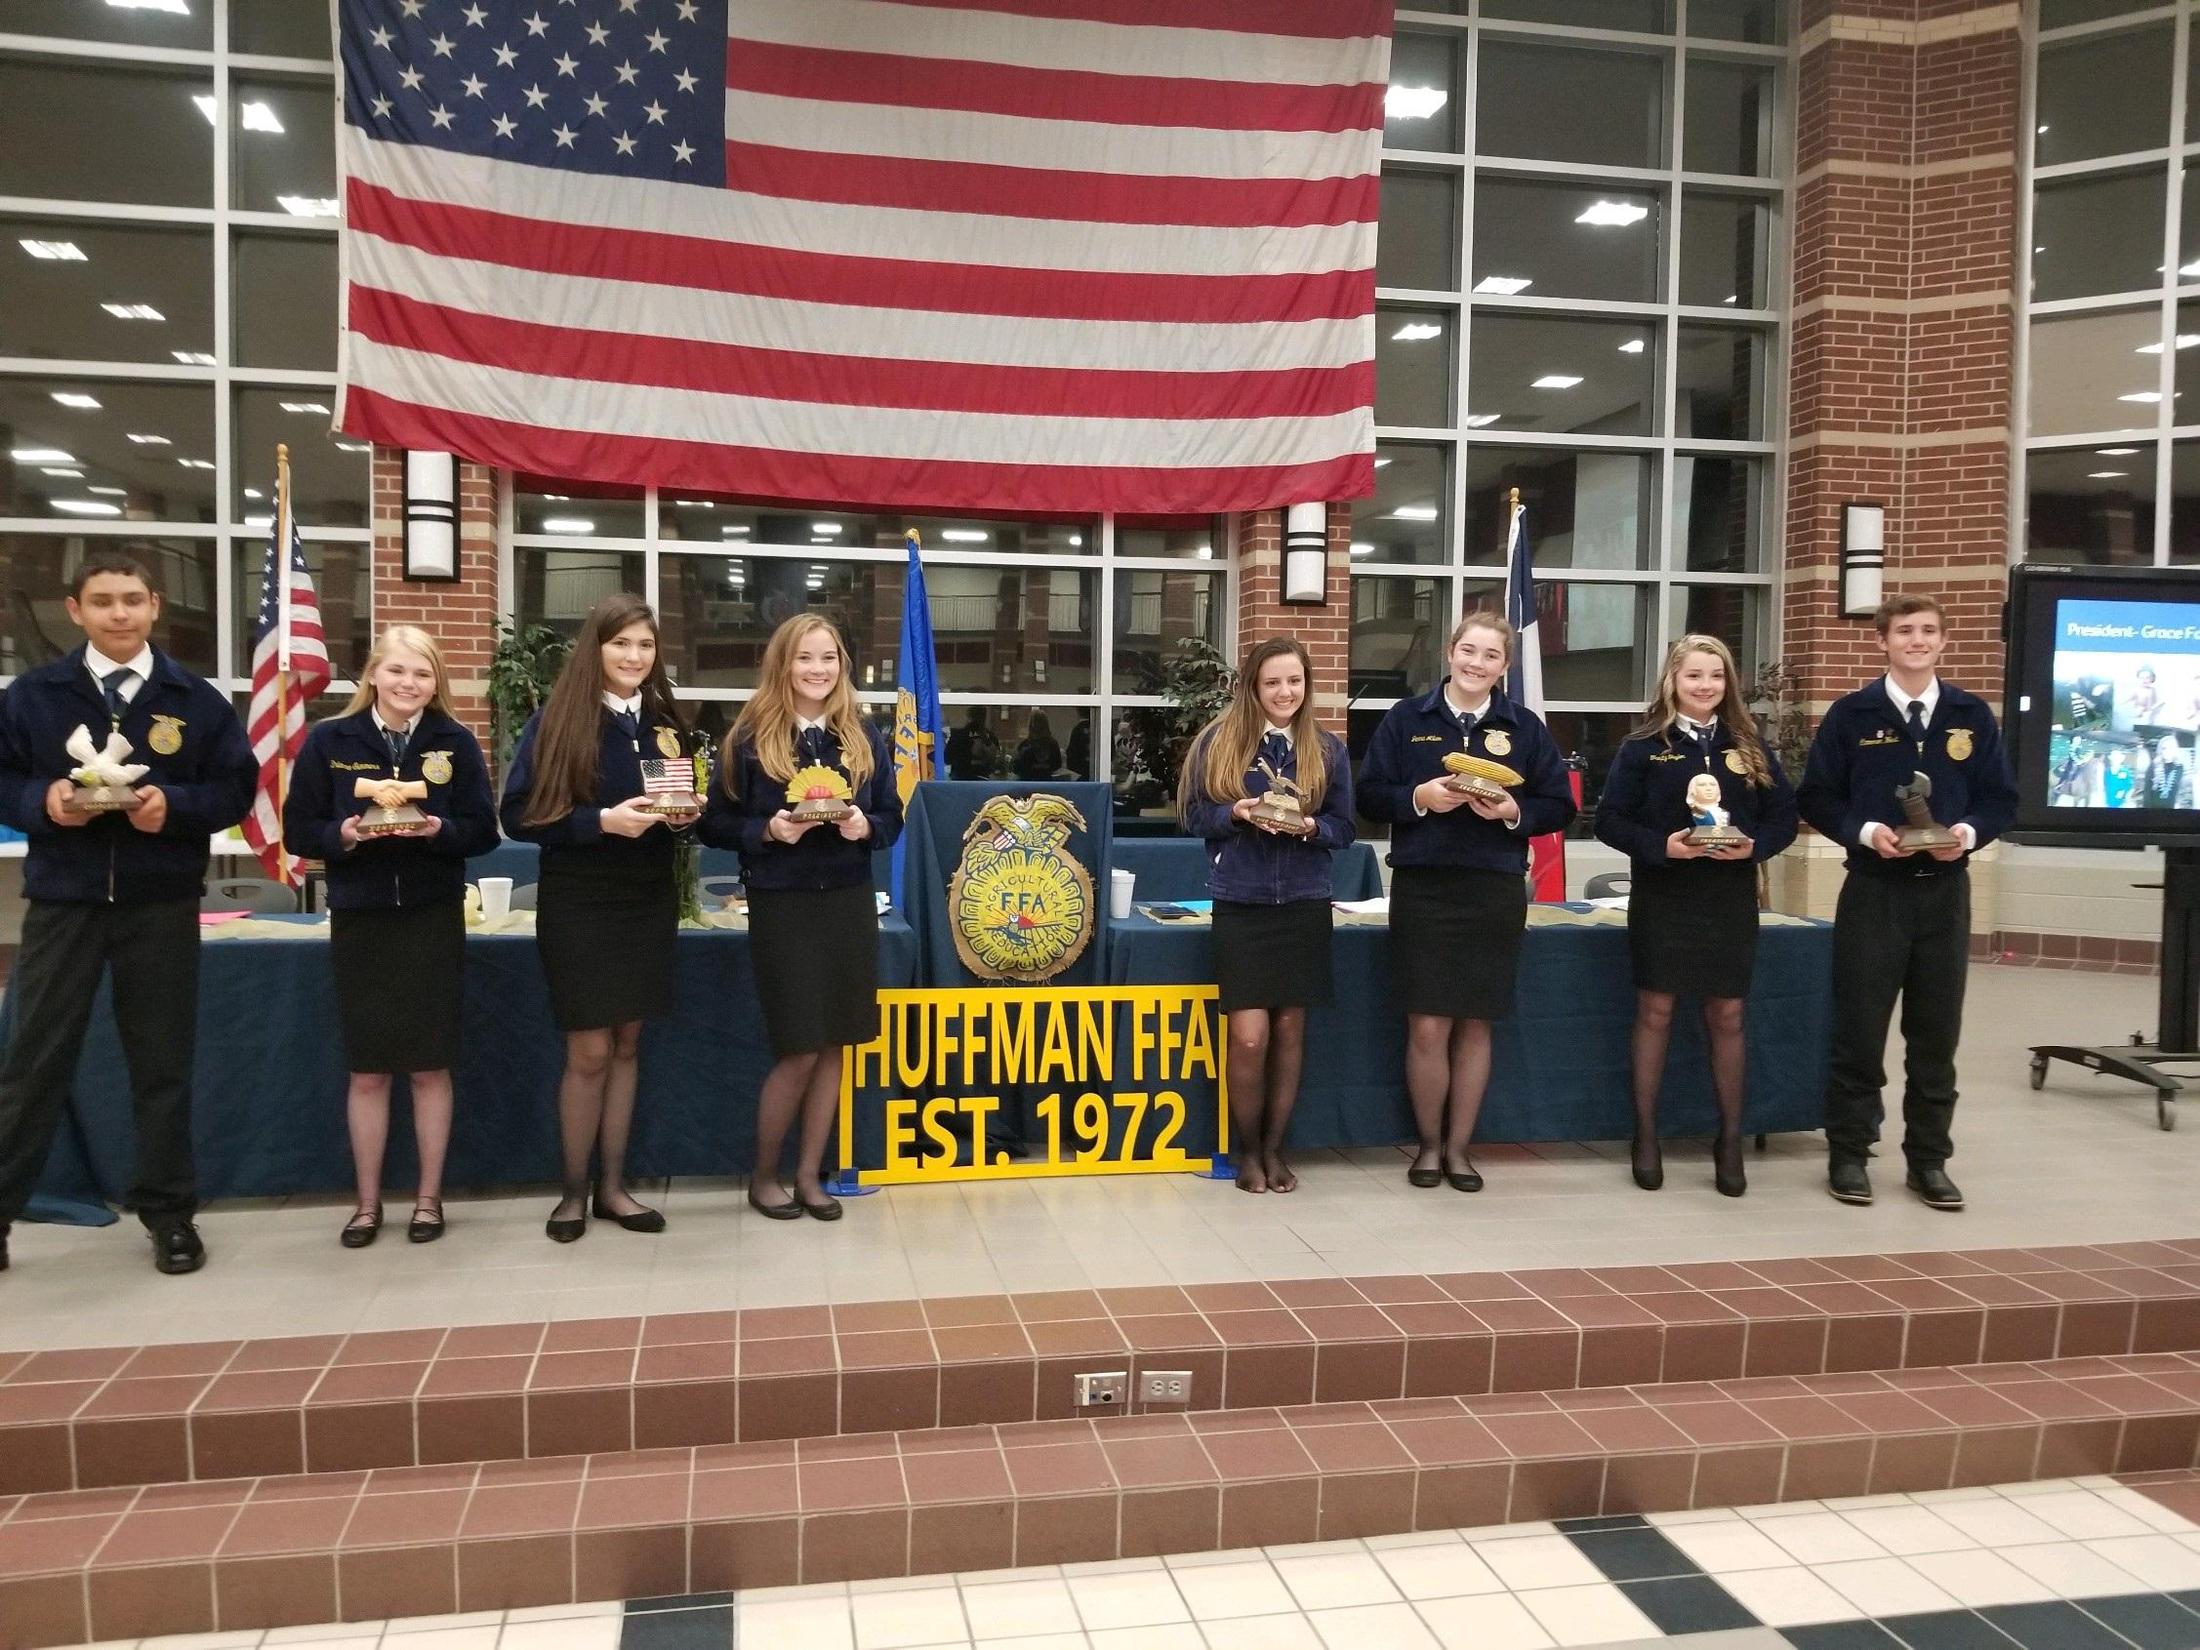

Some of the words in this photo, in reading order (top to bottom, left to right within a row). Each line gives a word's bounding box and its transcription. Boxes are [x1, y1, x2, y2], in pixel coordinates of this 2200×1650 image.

[2141, 624, 2183, 640] Grace
[985, 873, 1063, 918] AGRICULTURAL
[1001, 892, 1046, 914] FFA
[856, 998, 1112, 1088] HUFFMAN
[1132, 997, 1217, 1081] FFA
[886, 1096, 1013, 1170] EST.
[1036, 1091, 1187, 1164] 1972
